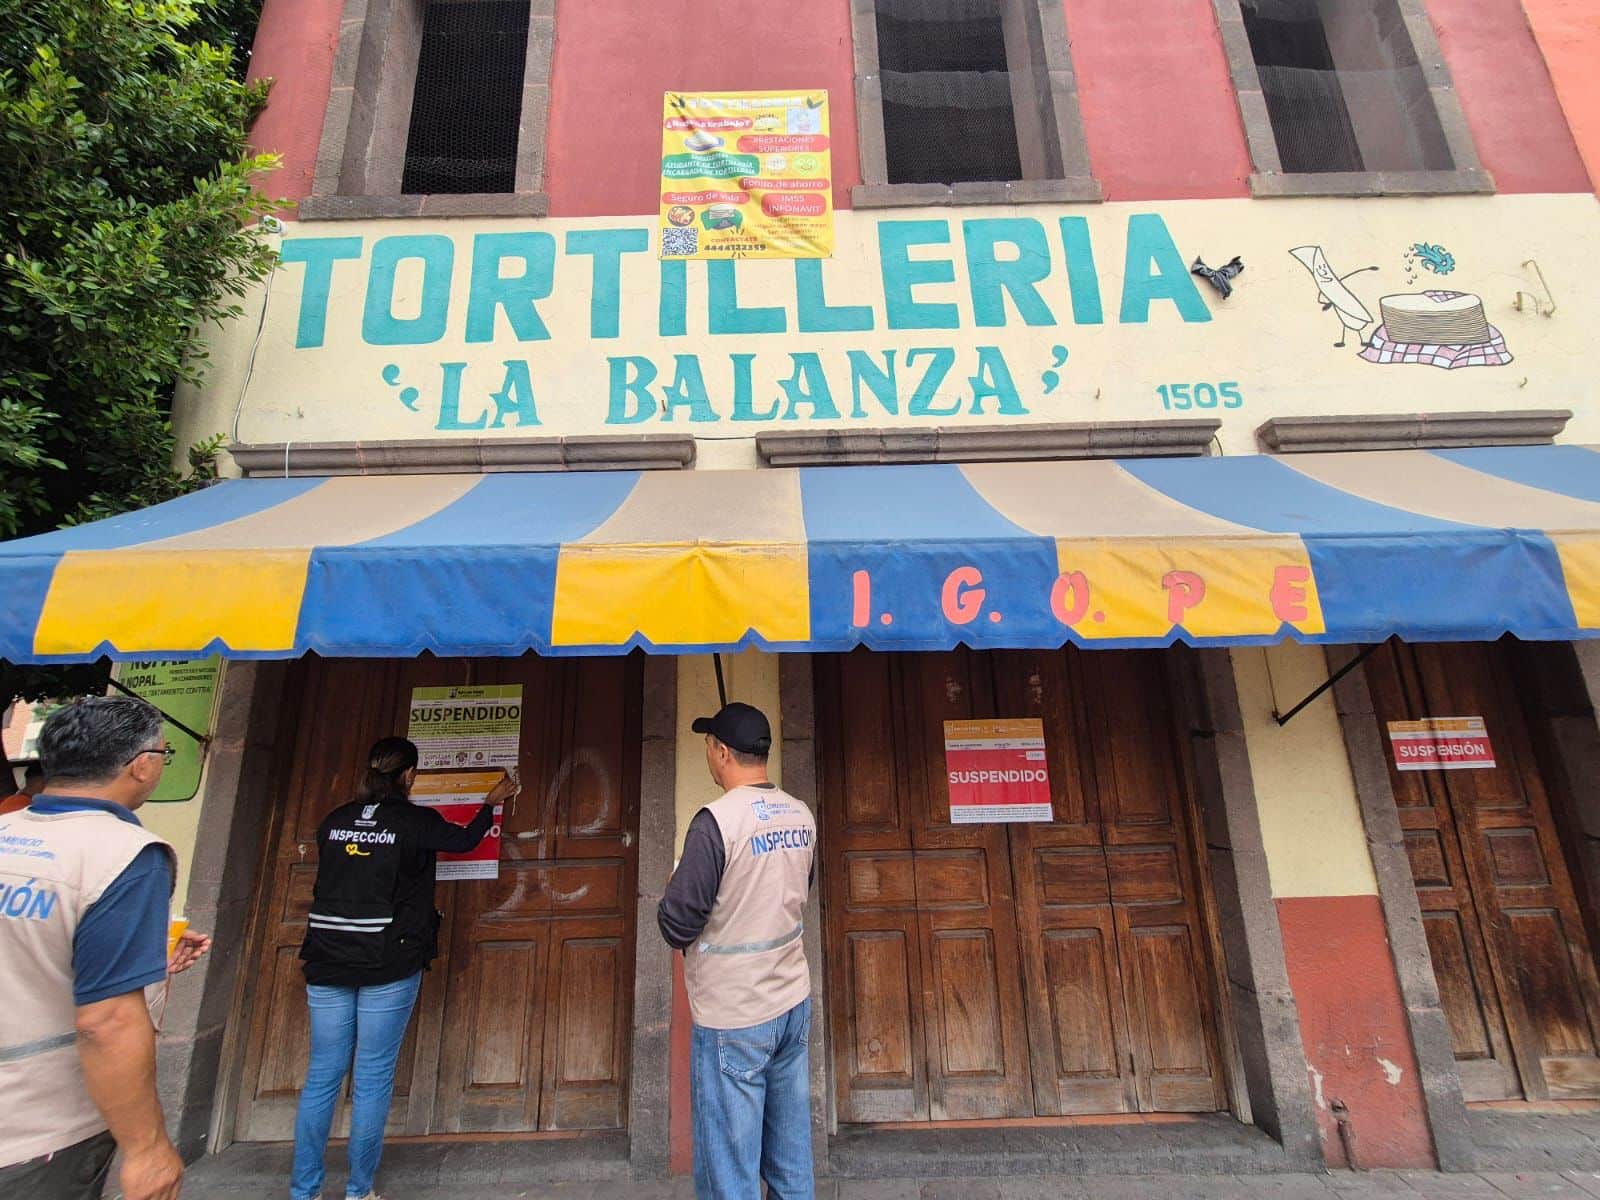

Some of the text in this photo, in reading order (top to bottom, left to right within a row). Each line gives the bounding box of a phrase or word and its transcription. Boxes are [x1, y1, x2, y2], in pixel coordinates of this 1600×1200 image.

[280, 213, 1212, 348] TORTILLERIA
[1156, 382, 1243, 410] 1505
[941, 566, 1002, 625] G.
[1162, 570, 1205, 623] P
[1270, 566, 1309, 622] E
[411, 705, 520, 722] SUSPENDIDO
[1400, 741, 1486, 758] SUSPENSIÓN
[950, 769, 1048, 784] SUSPENDIDO
[329, 829, 396, 845] INSPECCIÓN
